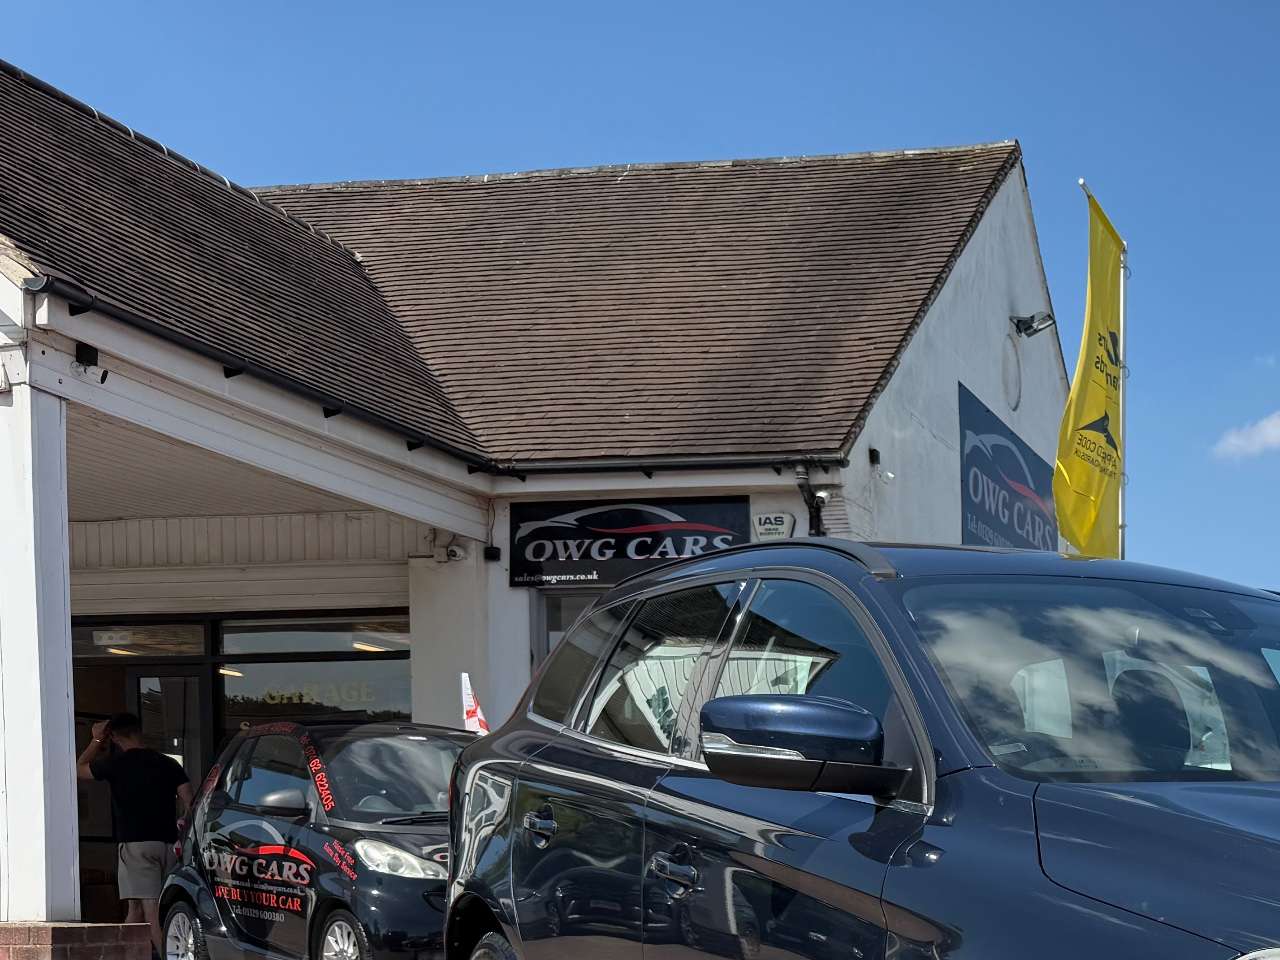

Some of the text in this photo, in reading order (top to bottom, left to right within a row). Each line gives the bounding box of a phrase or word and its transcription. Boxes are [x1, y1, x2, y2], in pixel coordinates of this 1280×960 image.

[758, 516, 785, 527] IAS
[969, 467, 1054, 552] OWG CARS
[524, 535, 733, 561] OWG CARS
[315, 772, 336, 812] 622405
[204, 850, 311, 884] OWG CARS
[214, 885, 302, 911] WE BUY YOUR CAR
